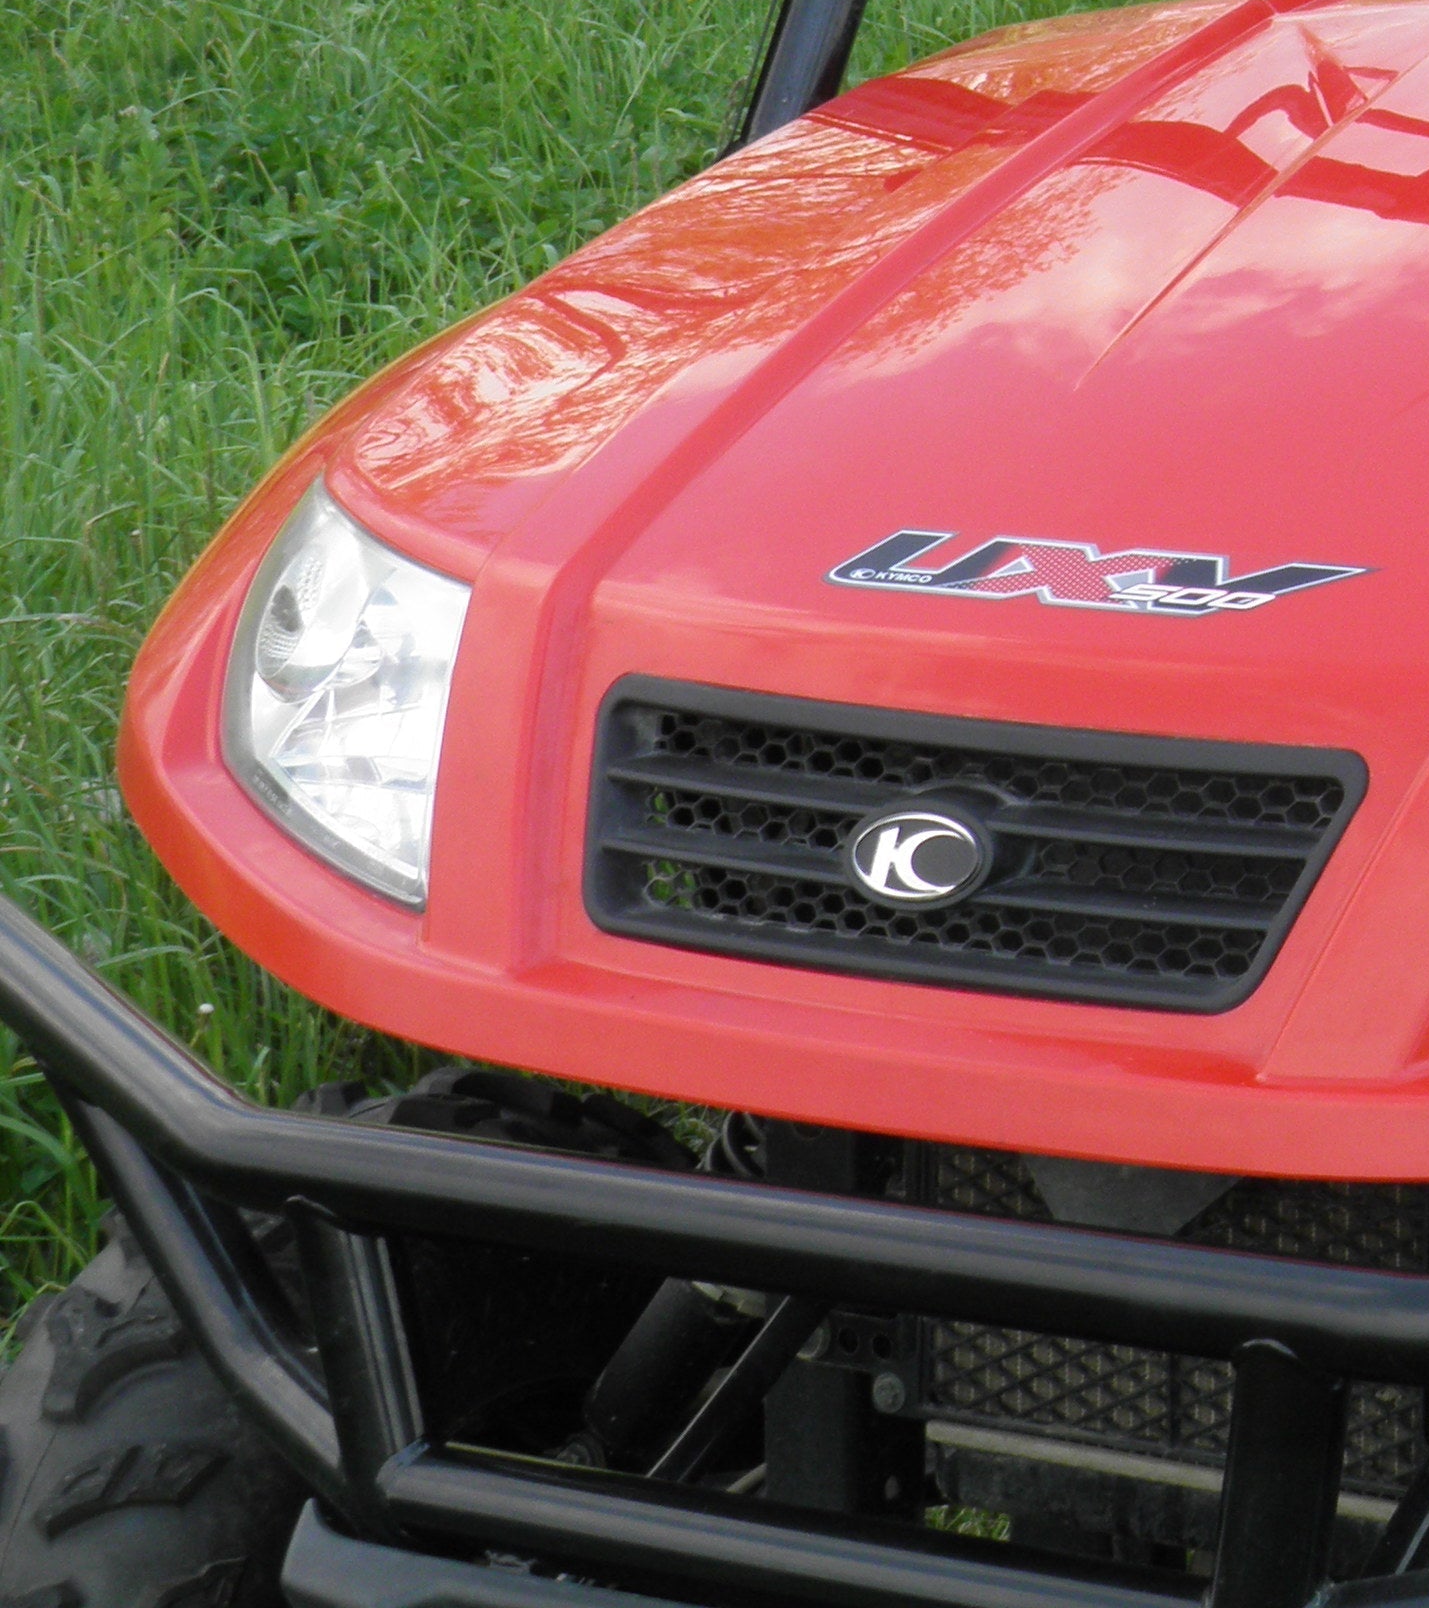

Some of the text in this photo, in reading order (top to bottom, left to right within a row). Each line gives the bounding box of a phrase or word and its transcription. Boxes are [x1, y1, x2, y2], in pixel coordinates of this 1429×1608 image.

[826, 529, 1380, 616] UXV
[875, 571, 933, 584] KYMCO
[1107, 583, 1277, 611] 500
